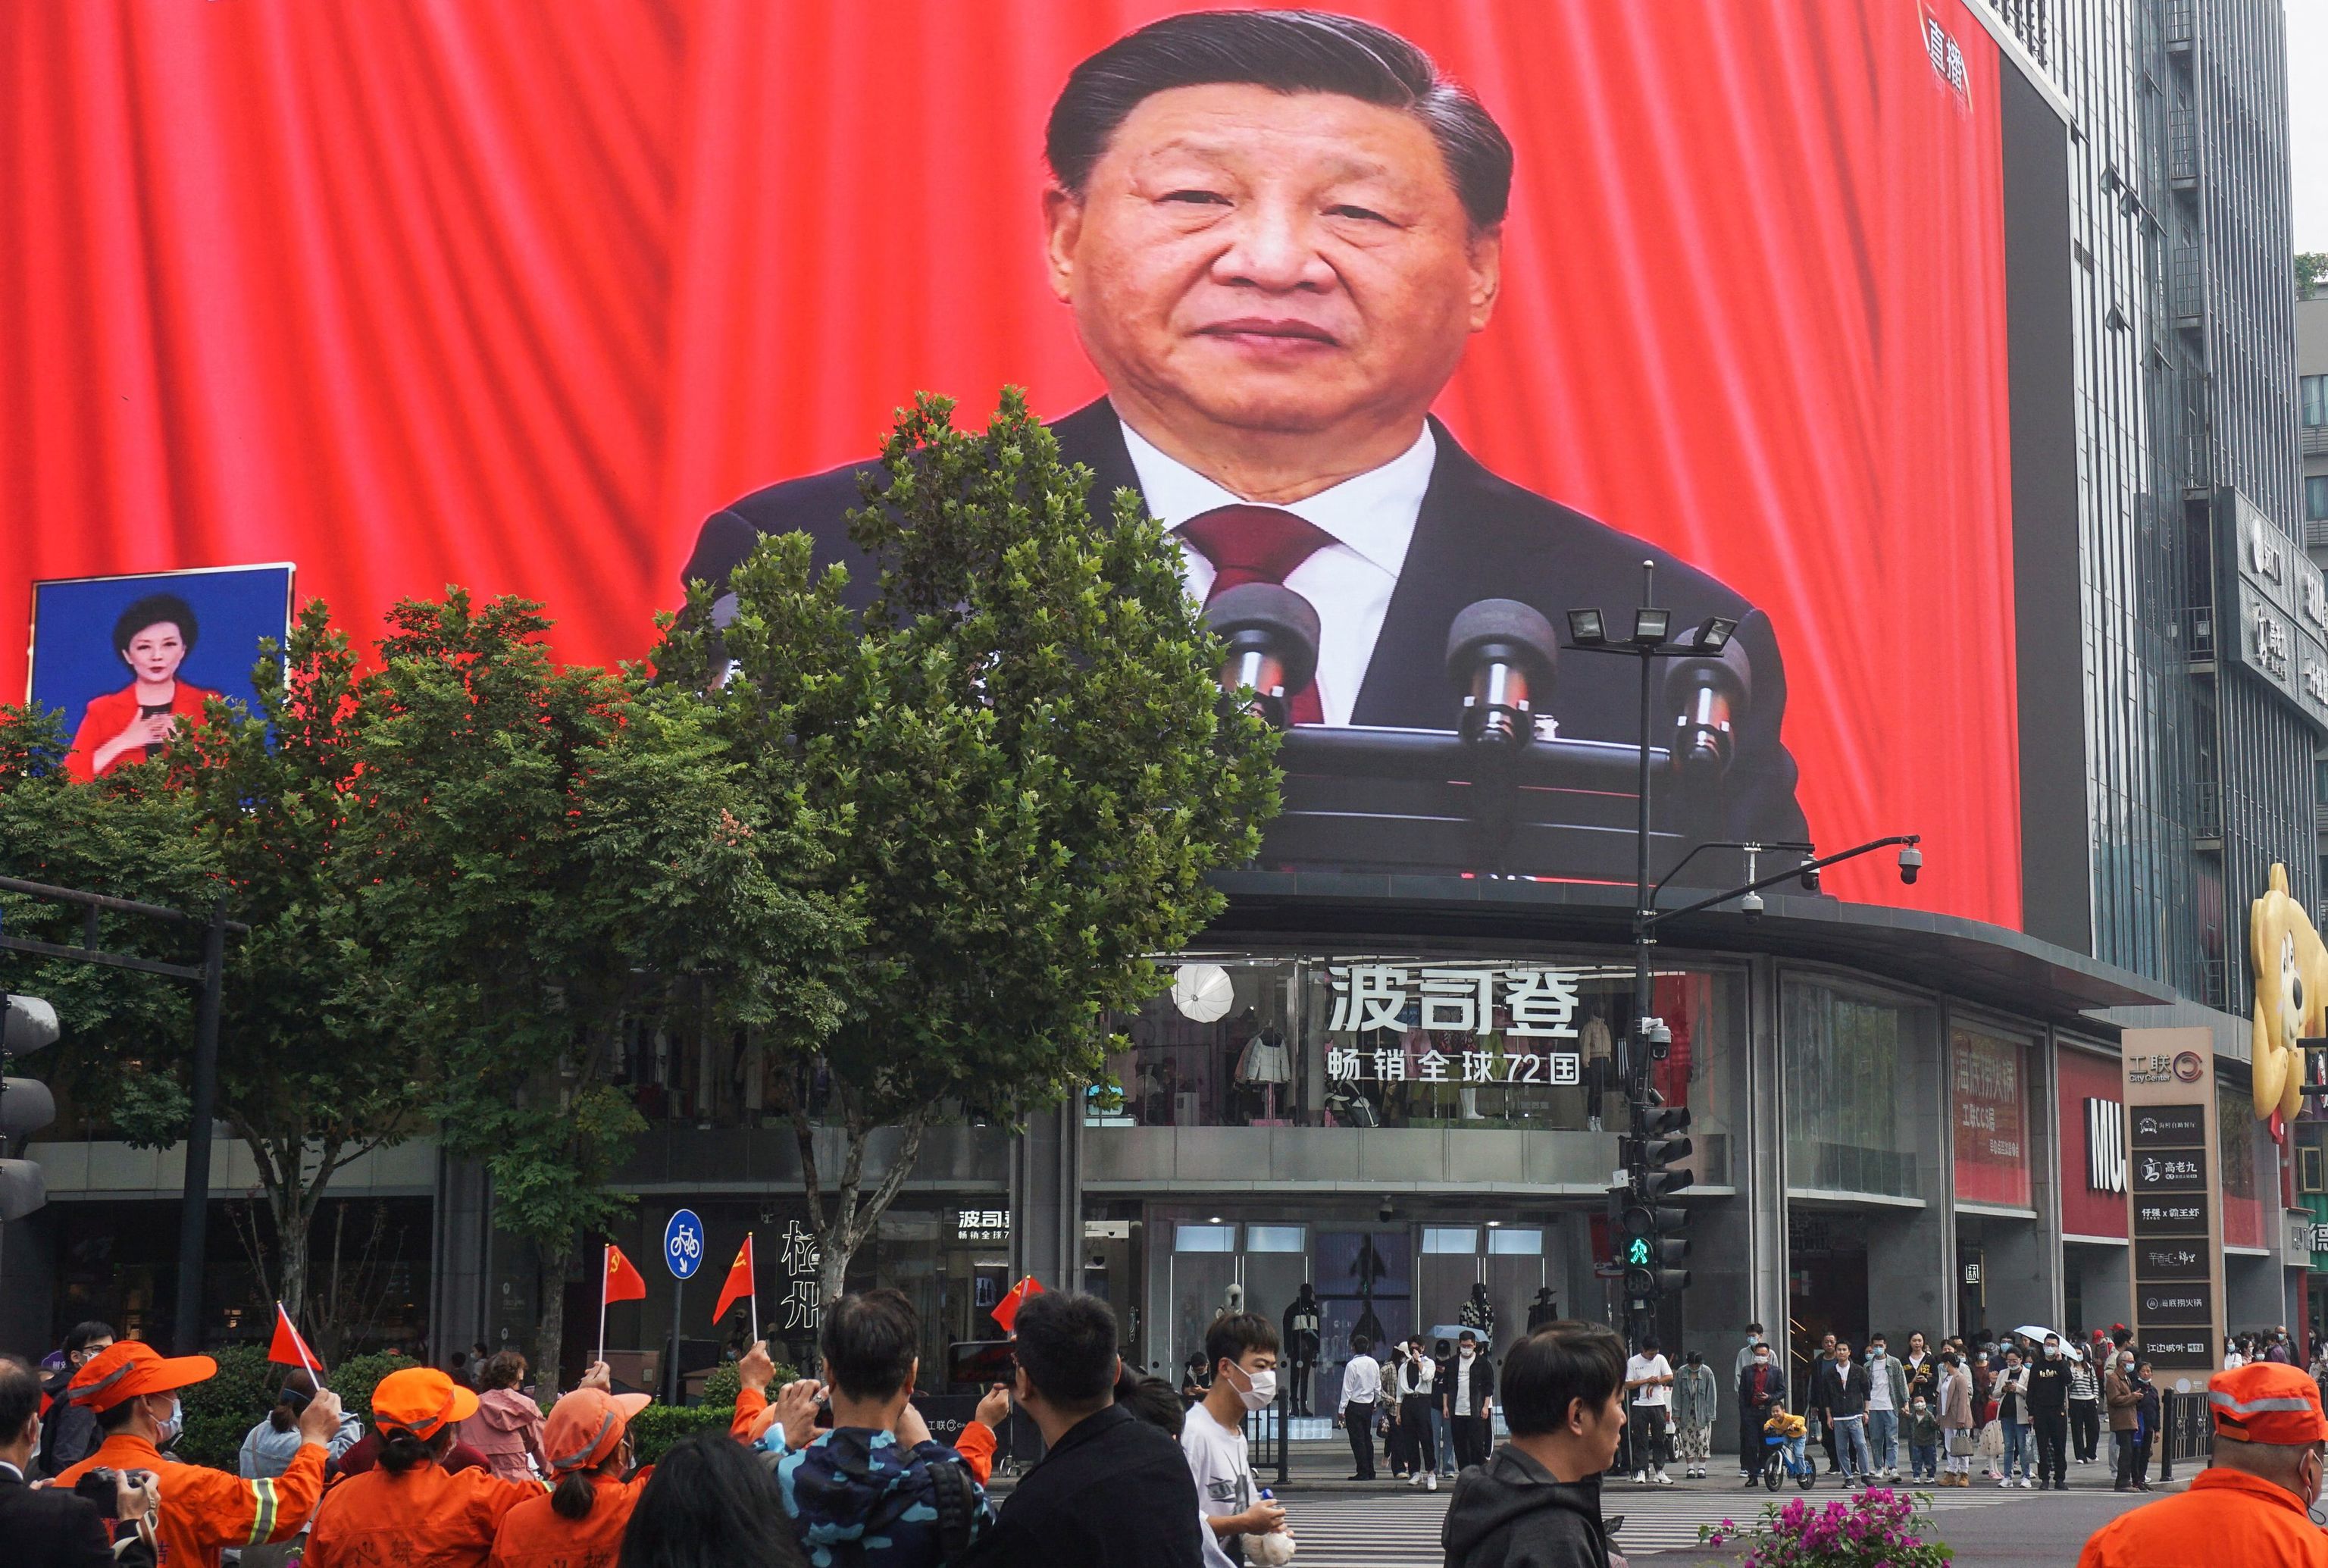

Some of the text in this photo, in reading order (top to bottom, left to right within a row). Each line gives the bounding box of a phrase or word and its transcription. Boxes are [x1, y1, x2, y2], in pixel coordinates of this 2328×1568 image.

[1929, 17, 1963, 92] 直播
[1328, 965, 1580, 1038] 波司登
[1328, 1047, 1580, 1085] 畅销全球72国
[2129, 1055, 2171, 1074] 工联
[2129, 1075, 2146, 1084] City
[2165, 1161, 2198, 1173] 高老九
[2142, 1208, 2161, 1217] 仔强
[2160, 1298, 2202, 1308] 海底捞火锅
[2147, 1344, 2186, 1353] 江边城外
[928, 1421, 946, 1430] 工联
